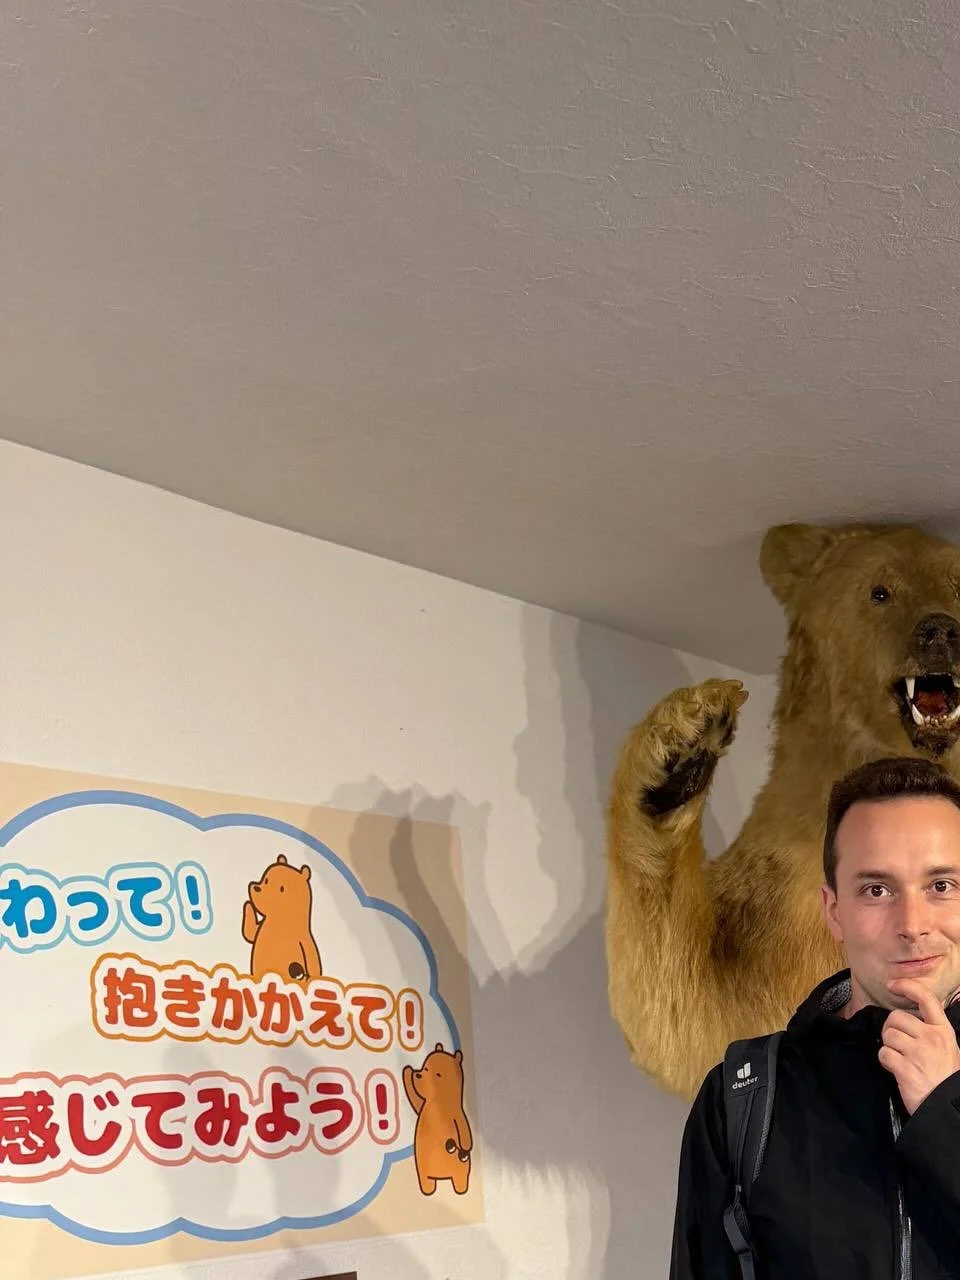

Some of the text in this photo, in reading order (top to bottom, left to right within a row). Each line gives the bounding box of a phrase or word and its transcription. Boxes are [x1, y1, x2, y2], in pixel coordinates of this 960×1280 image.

[0, 875, 203, 938] わって！
[103, 967, 416, 1042] 抱きかかえて！
[732, 1076, 758, 1090] deuter
[0, 1082, 389, 1165] 感じてみよう！
